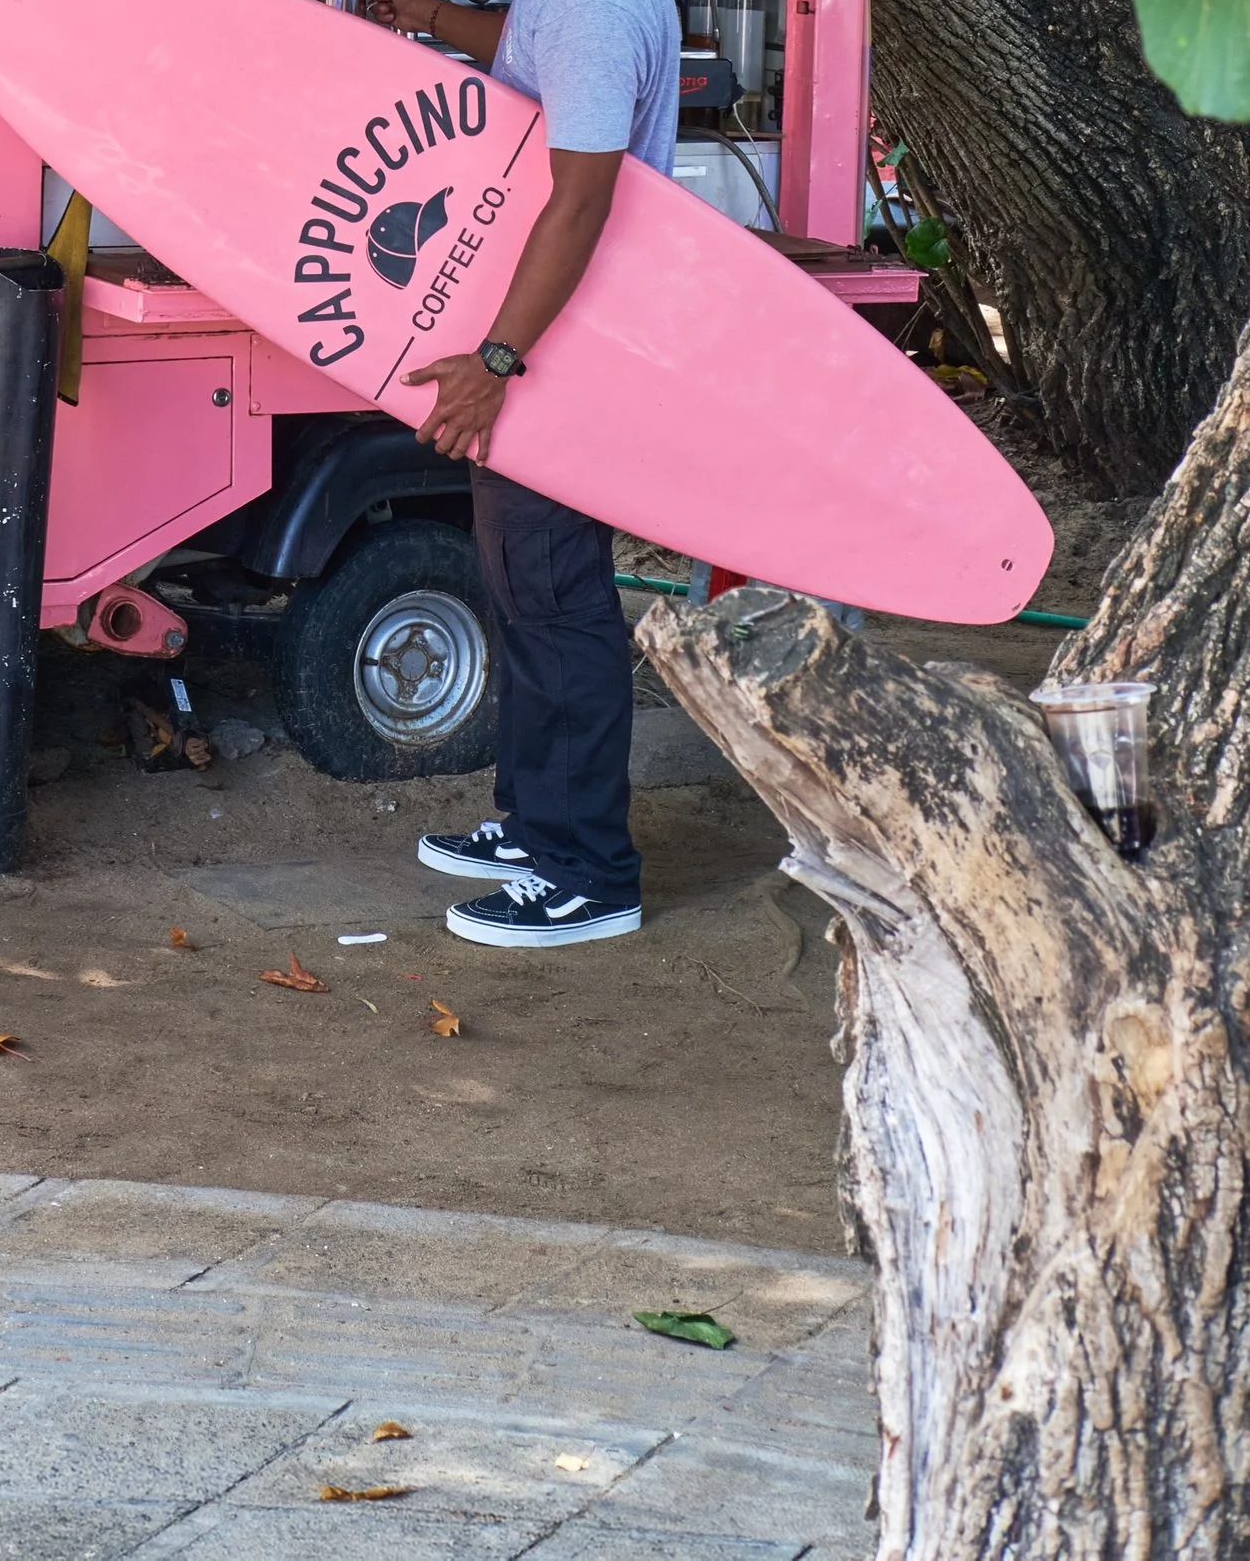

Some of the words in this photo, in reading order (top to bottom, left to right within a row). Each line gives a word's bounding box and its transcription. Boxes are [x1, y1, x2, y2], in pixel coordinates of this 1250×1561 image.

[294, 77, 486, 367] CAPPUCCINO
[412, 227, 484, 332] COFFEE
[472, 186, 512, 226] CO.
